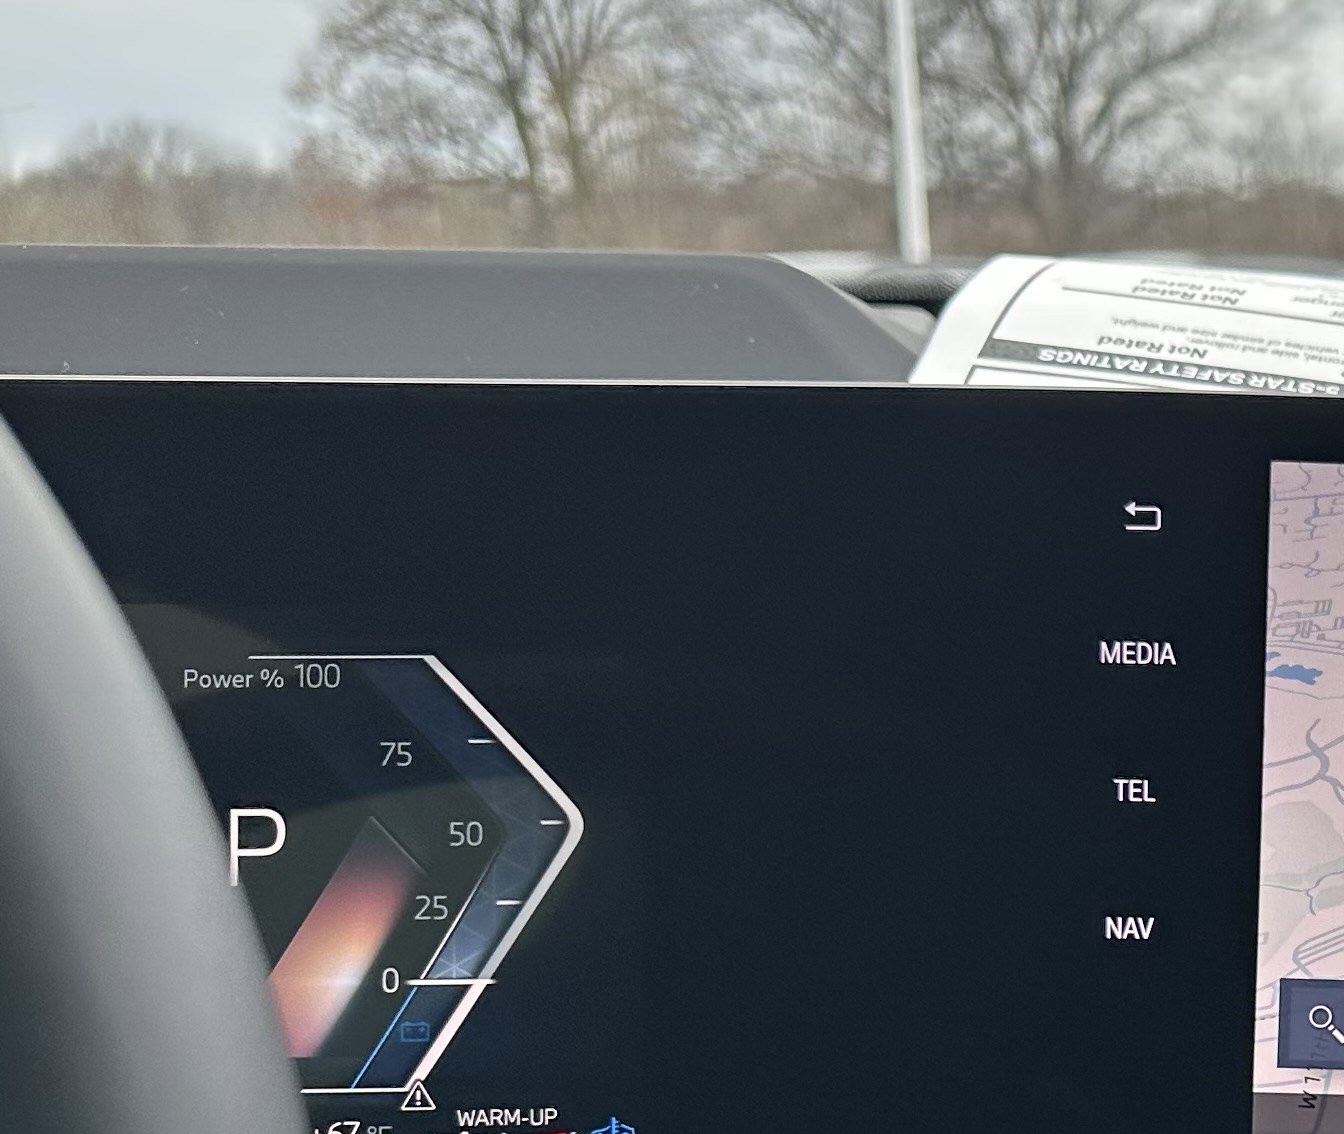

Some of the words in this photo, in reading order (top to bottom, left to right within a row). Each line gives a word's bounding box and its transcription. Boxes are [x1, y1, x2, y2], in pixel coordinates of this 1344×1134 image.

[1099, 335, 1164, 353] Rated
[1169, 344, 1208, 359] Not
[1037, 347, 1148, 373] RATINGS
[1150, 360, 1247, 384] SAFETY
[1100, 641, 1176, 665] MEDIA
[183, 669, 253, 689] Power
[260, 669, 284, 688] %
[294, 664, 341, 688] 100
[380, 742, 413, 767] 75
[1113, 778, 1156, 803] TEL
[229, 808, 287, 886] P
[448, 822, 483, 847] 50
[414, 896, 449, 921] 25
[1104, 916, 1154, 940] NAV
[381, 968, 400, 994] 0
[456, 1108, 558, 1128] WARM-UP
